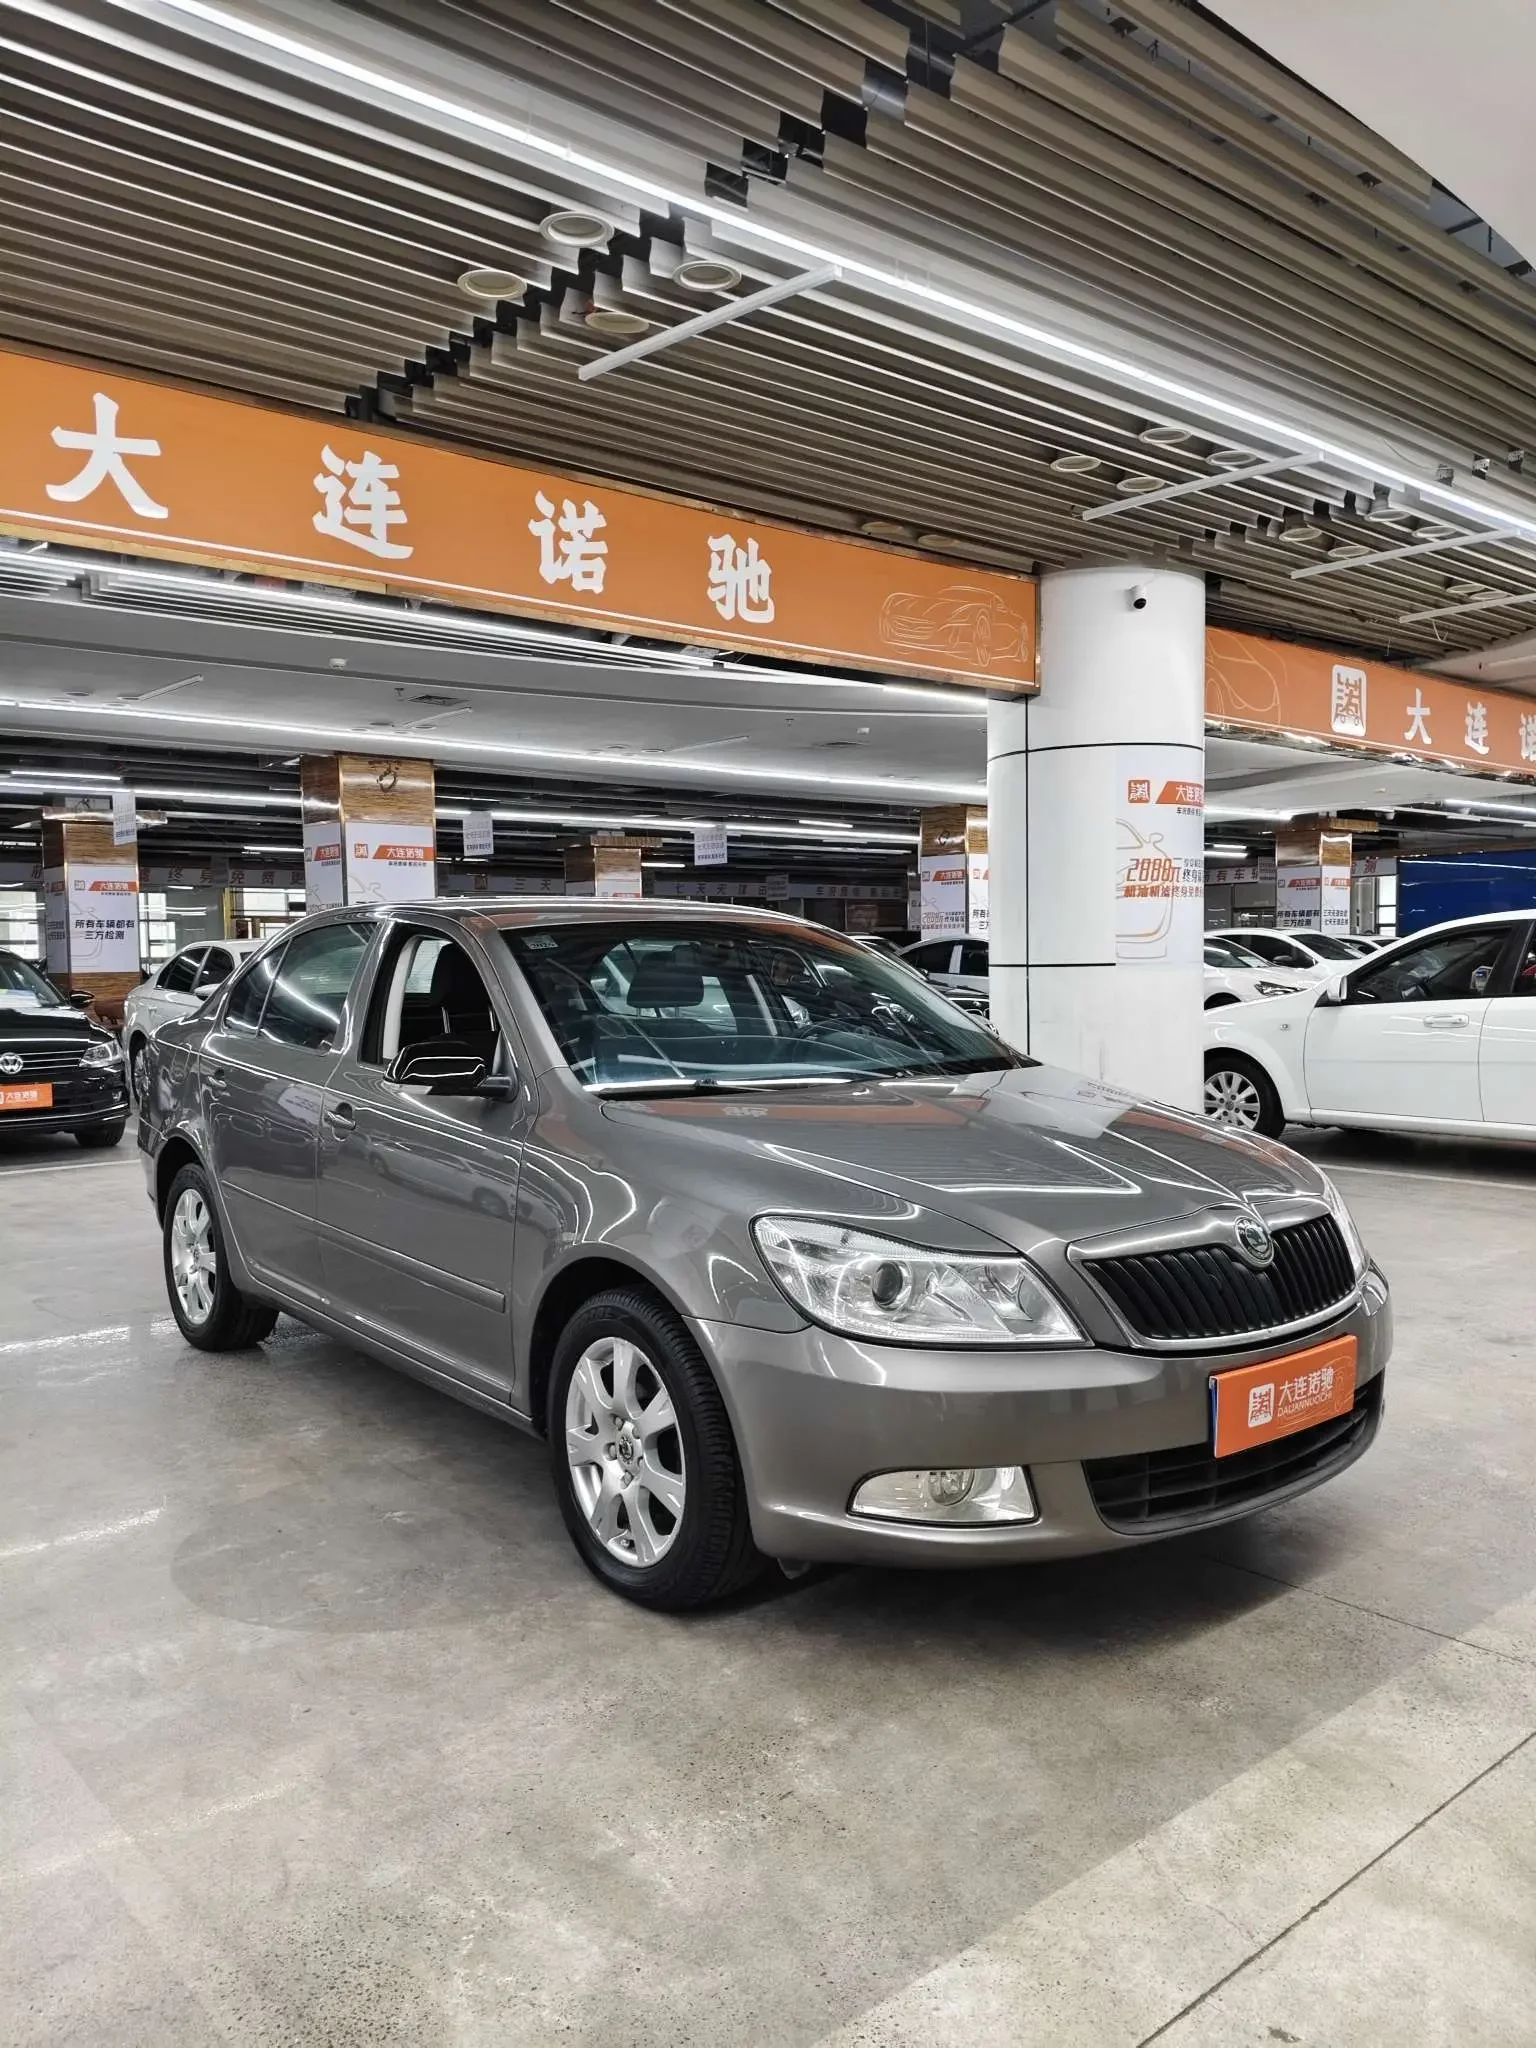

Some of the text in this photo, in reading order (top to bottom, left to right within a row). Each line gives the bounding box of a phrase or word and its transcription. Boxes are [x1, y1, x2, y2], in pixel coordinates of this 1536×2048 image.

[46, 392, 776, 624] 大连诺驰
[75, 920, 135, 929] 所有车辆都有
[84, 931, 125, 940] 三方检测
[1278, 1366, 1334, 1407] 大连诺驰
